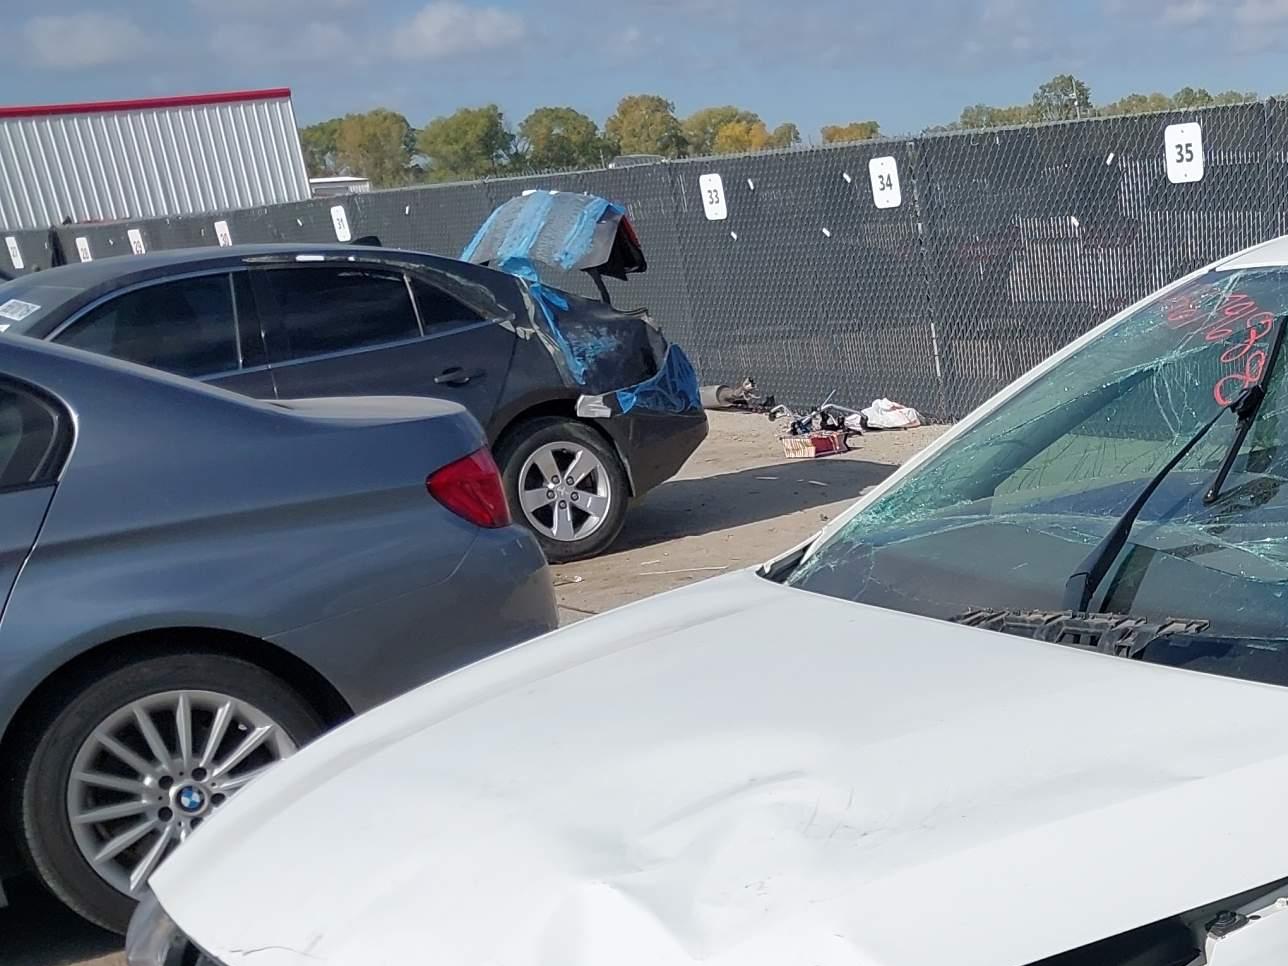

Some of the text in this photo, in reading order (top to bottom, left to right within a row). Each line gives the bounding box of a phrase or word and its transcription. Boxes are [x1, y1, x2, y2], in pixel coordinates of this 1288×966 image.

[1174, 142, 1194, 163] 35
[877, 172, 893, 192] 34
[706, 188, 720, 205] 33
